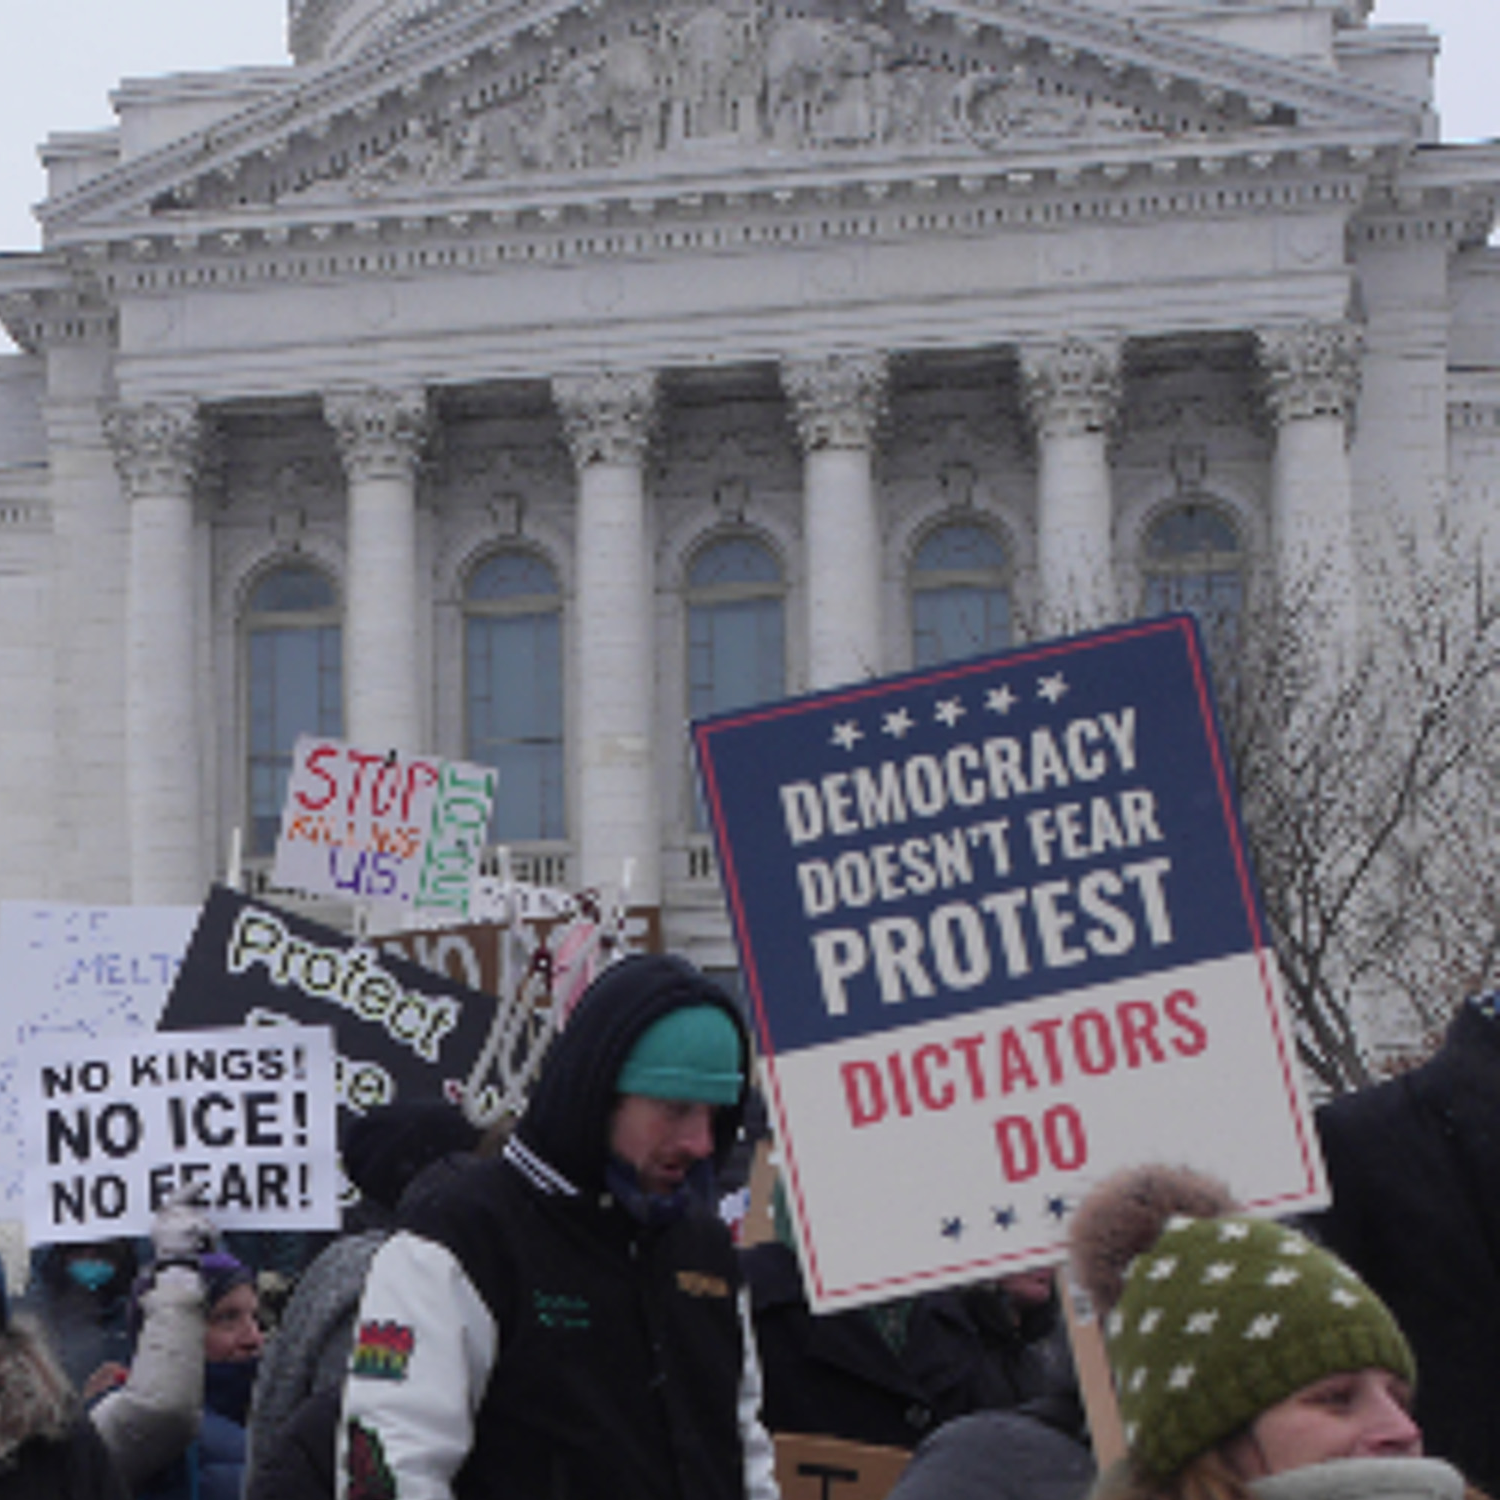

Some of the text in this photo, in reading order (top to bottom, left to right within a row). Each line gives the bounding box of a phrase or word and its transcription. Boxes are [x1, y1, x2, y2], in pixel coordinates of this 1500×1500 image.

[295, 744, 439, 822] STOP
[780, 708, 1138, 845] DEMOCRACY
[797, 788, 1164, 918] DOESN'T FEAR
[65, 952, 185, 986] MELT
[811, 857, 1172, 1016] PROTEST
[228, 906, 461, 1062] Protect
[41, 1061, 110, 1098] NO
[130, 1045, 307, 1088] KINGS!
[840, 989, 1208, 1129] DICTATORS
[46, 1102, 142, 1166] NO
[167, 1091, 308, 1150] ICE!
[994, 1103, 1089, 1183] DO
[52, 1162, 310, 1225] NO FEAR!
